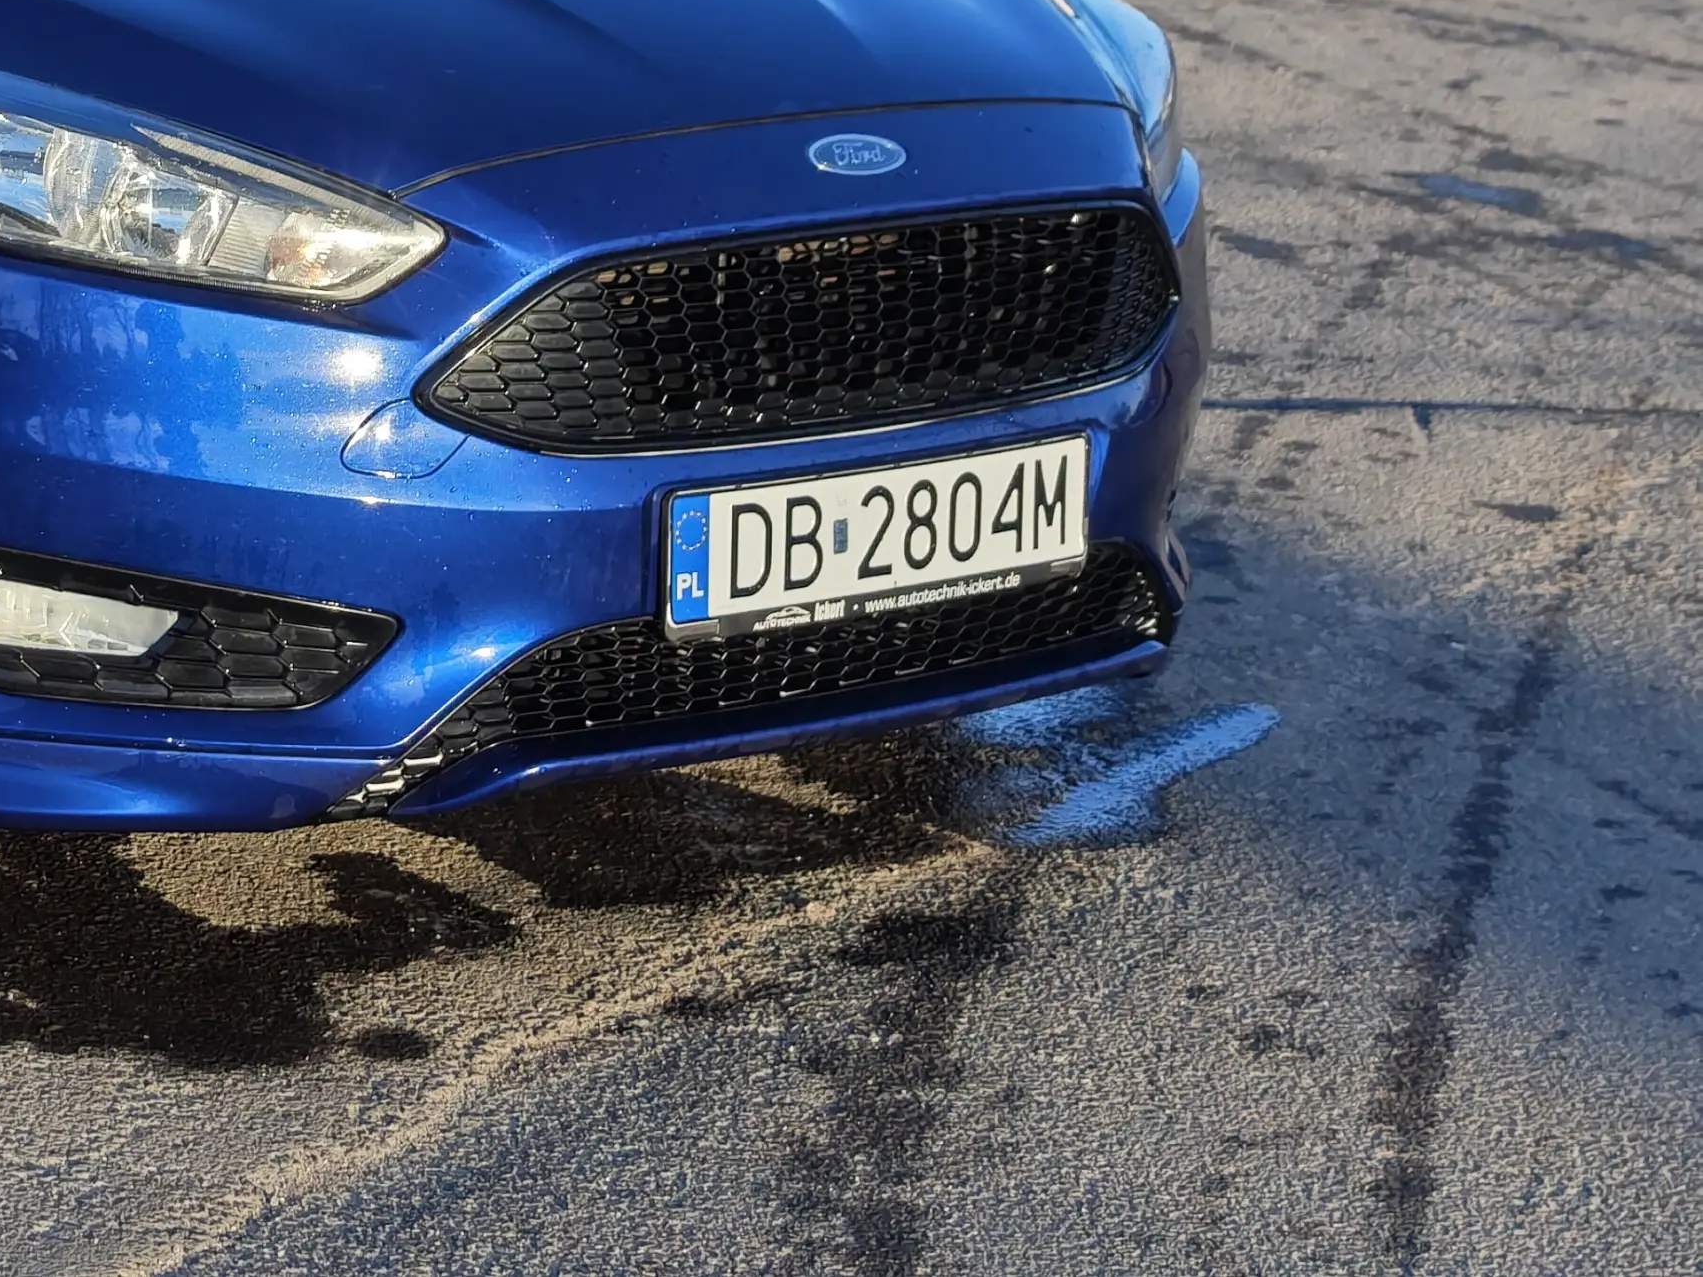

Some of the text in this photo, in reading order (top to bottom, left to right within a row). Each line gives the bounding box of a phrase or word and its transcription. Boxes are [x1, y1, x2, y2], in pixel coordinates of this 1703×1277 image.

[832, 142, 886, 166] Ford
[730, 455, 1068, 599] DB 2804M
[677, 572, 704, 601] PL
[864, 572, 1020, 613] www.autotechnik-ickert.de
